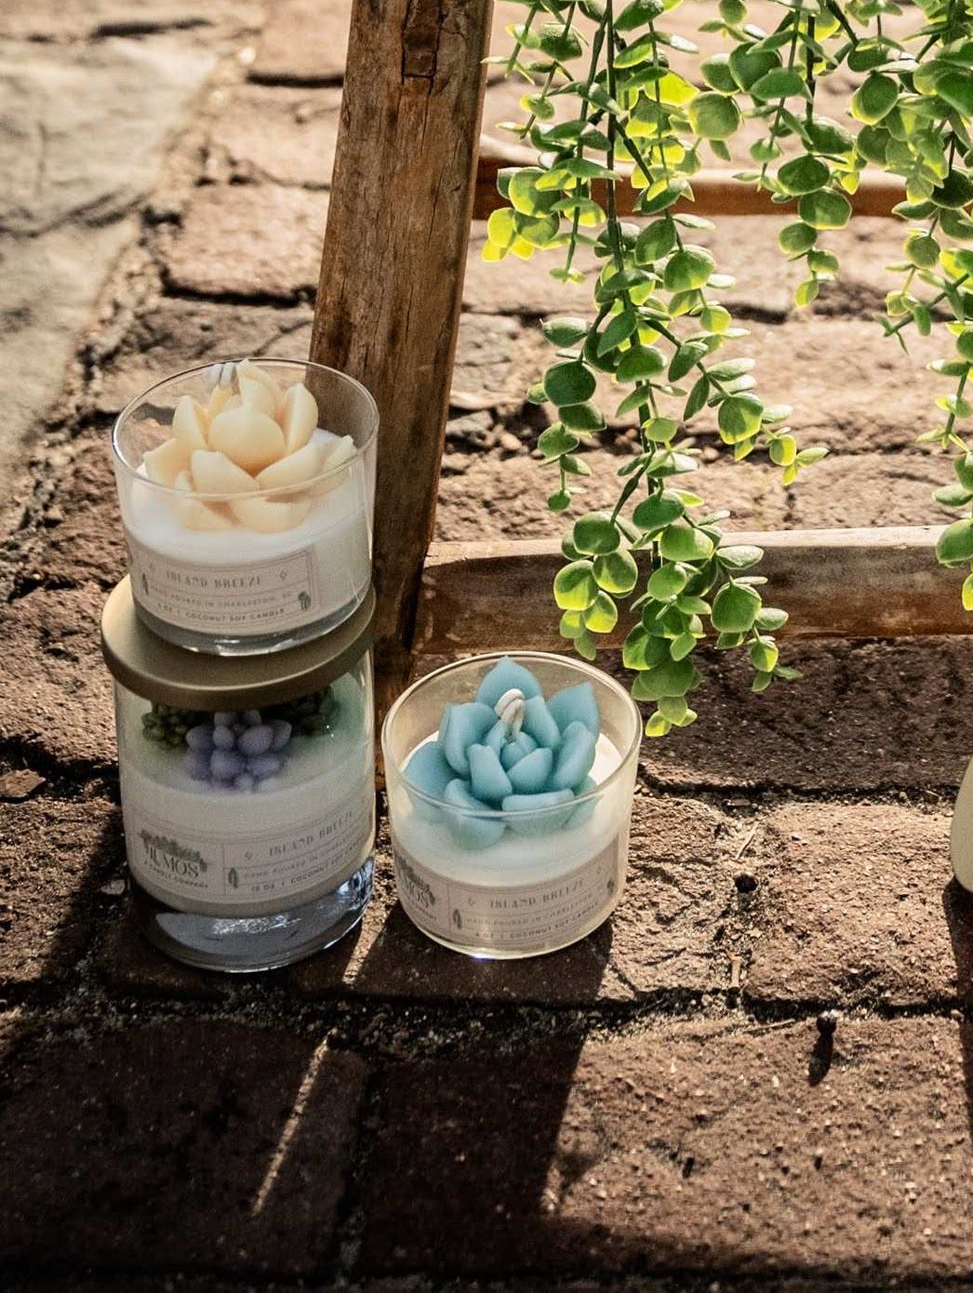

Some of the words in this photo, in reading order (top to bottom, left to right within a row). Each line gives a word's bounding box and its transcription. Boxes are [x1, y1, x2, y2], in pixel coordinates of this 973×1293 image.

[166, 570, 208, 588] ISLAND
[214, 575, 261, 589] BREEZE
[490, 897, 536, 909] ISLAND
